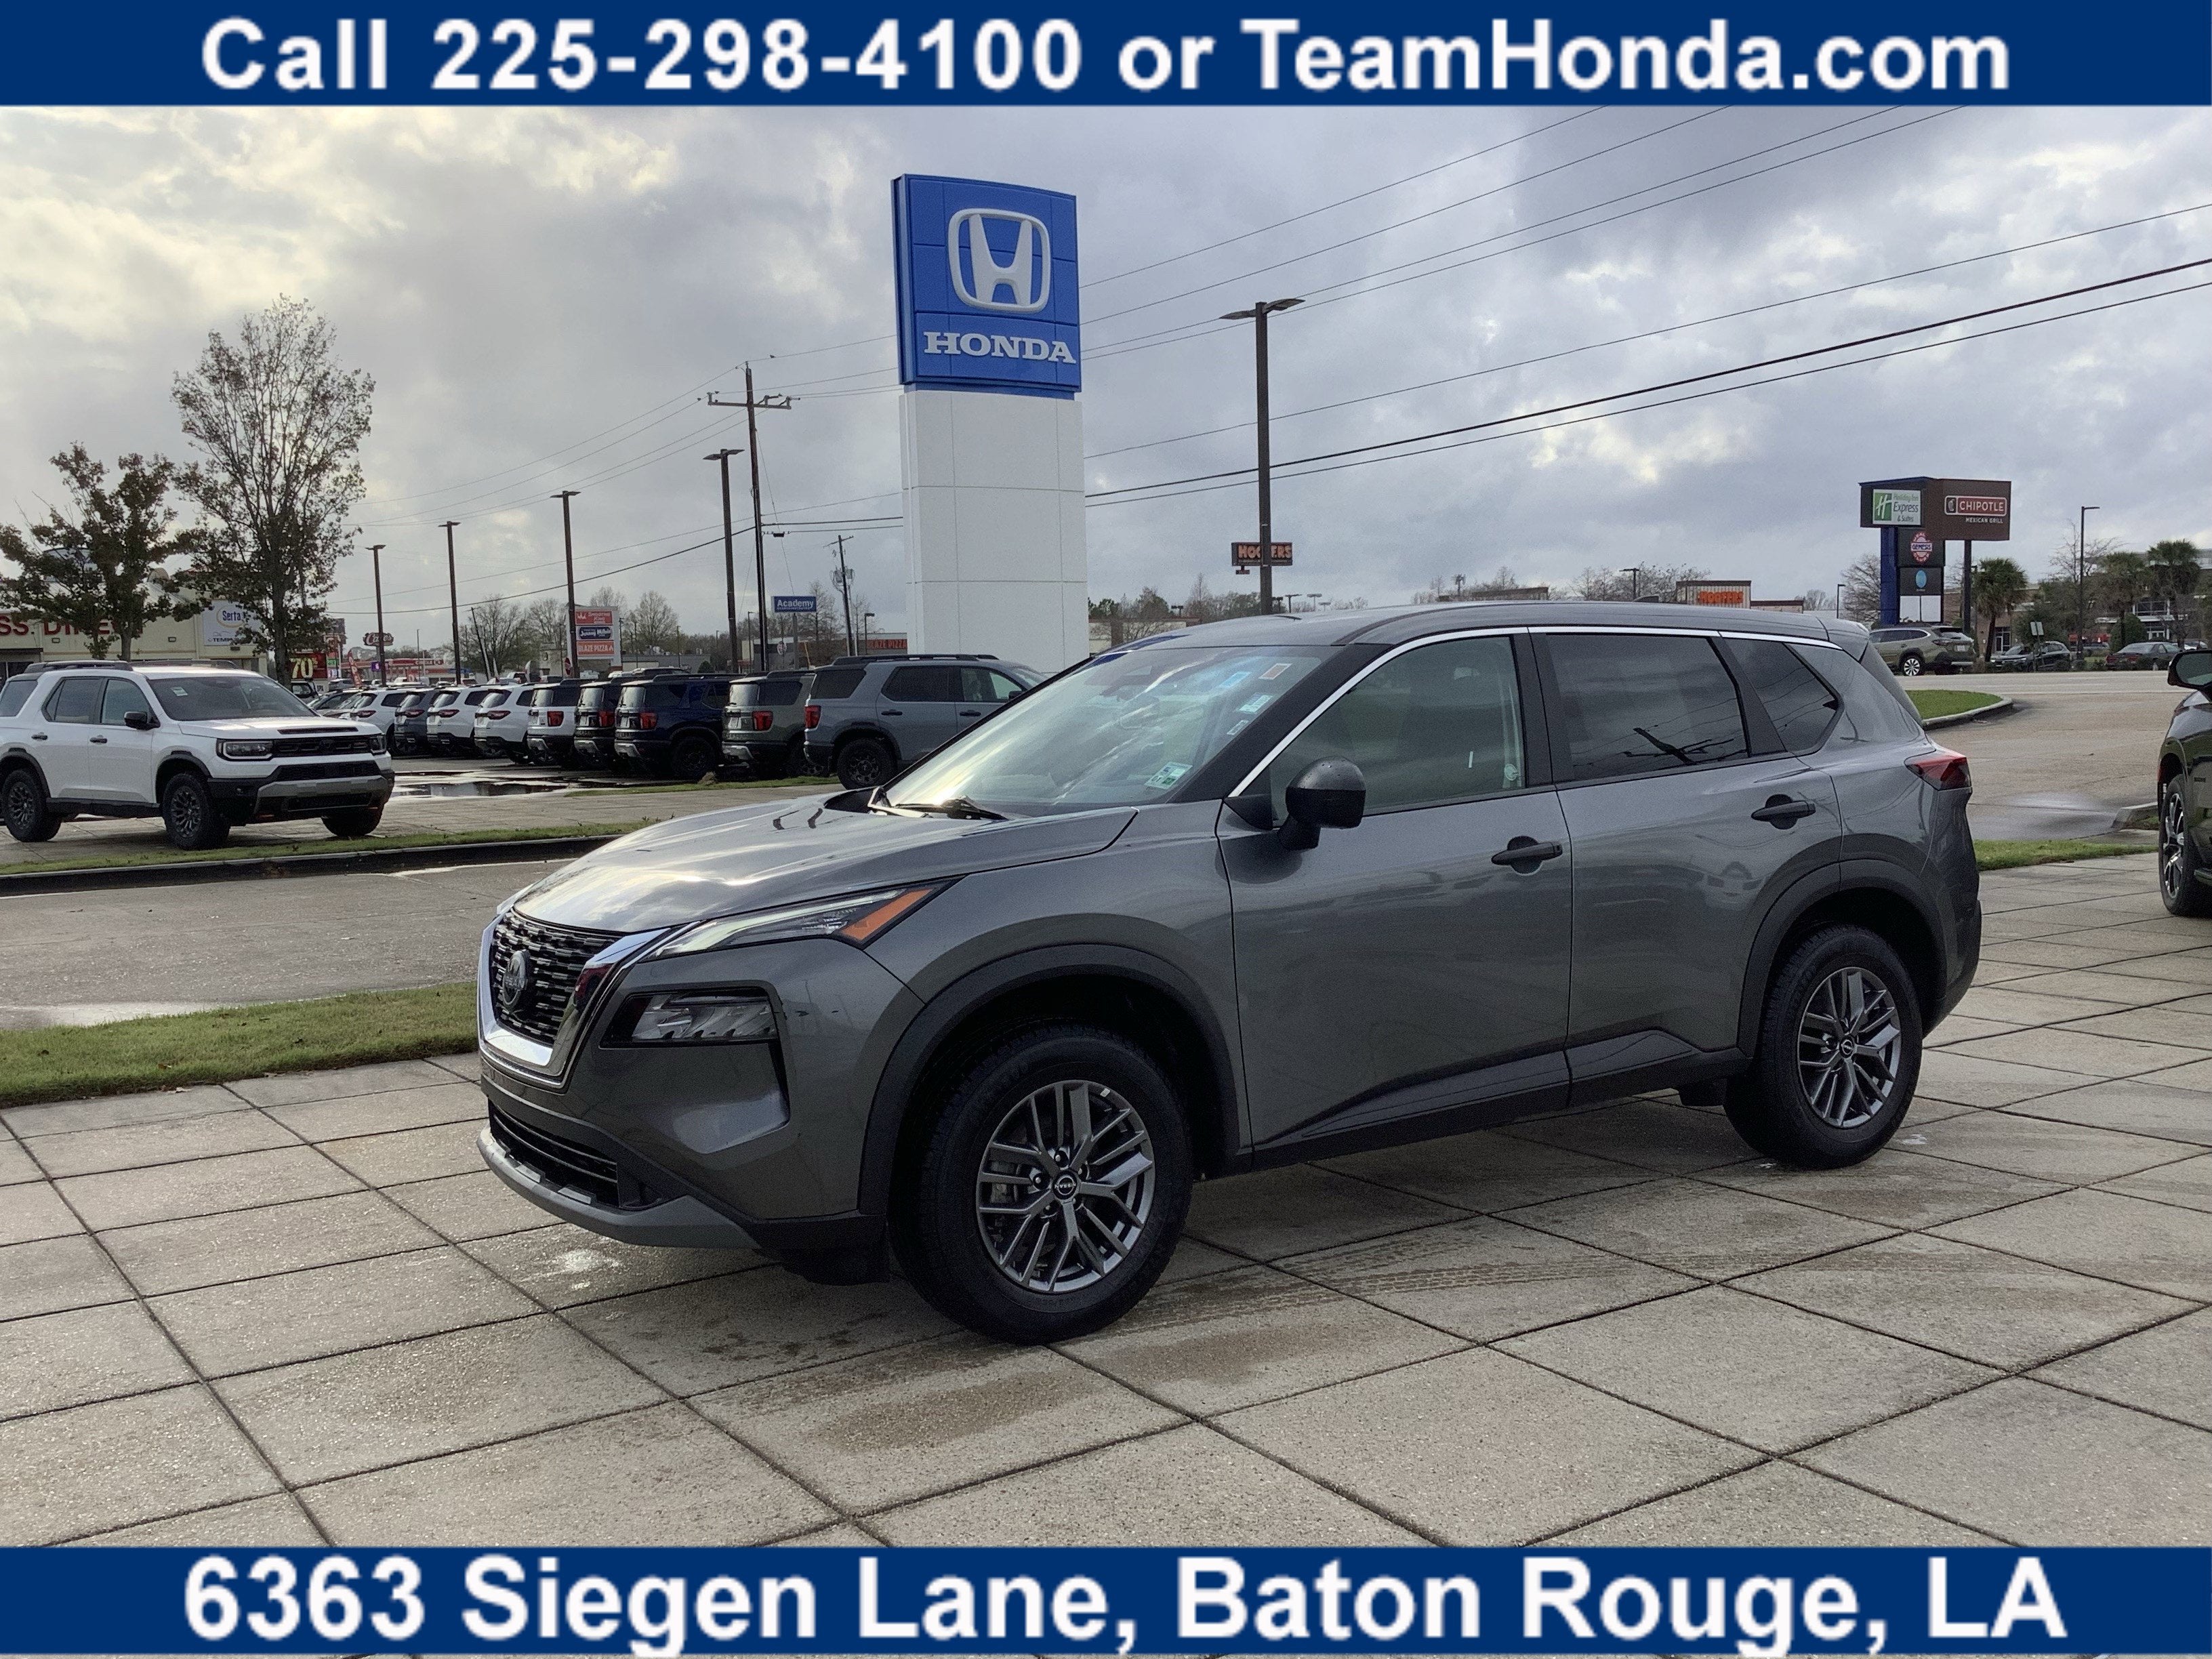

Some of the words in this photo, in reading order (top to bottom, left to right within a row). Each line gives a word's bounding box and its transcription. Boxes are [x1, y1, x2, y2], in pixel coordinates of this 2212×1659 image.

[923, 331, 1077, 365] HONDA
[1893, 501, 1919, 514] Express
[1959, 500, 2004, 512] CHIPOTLE
[777, 599, 814, 609] Academy
[222, 611, 241, 621] Serta
[888, 640, 907, 649] PIZZA
